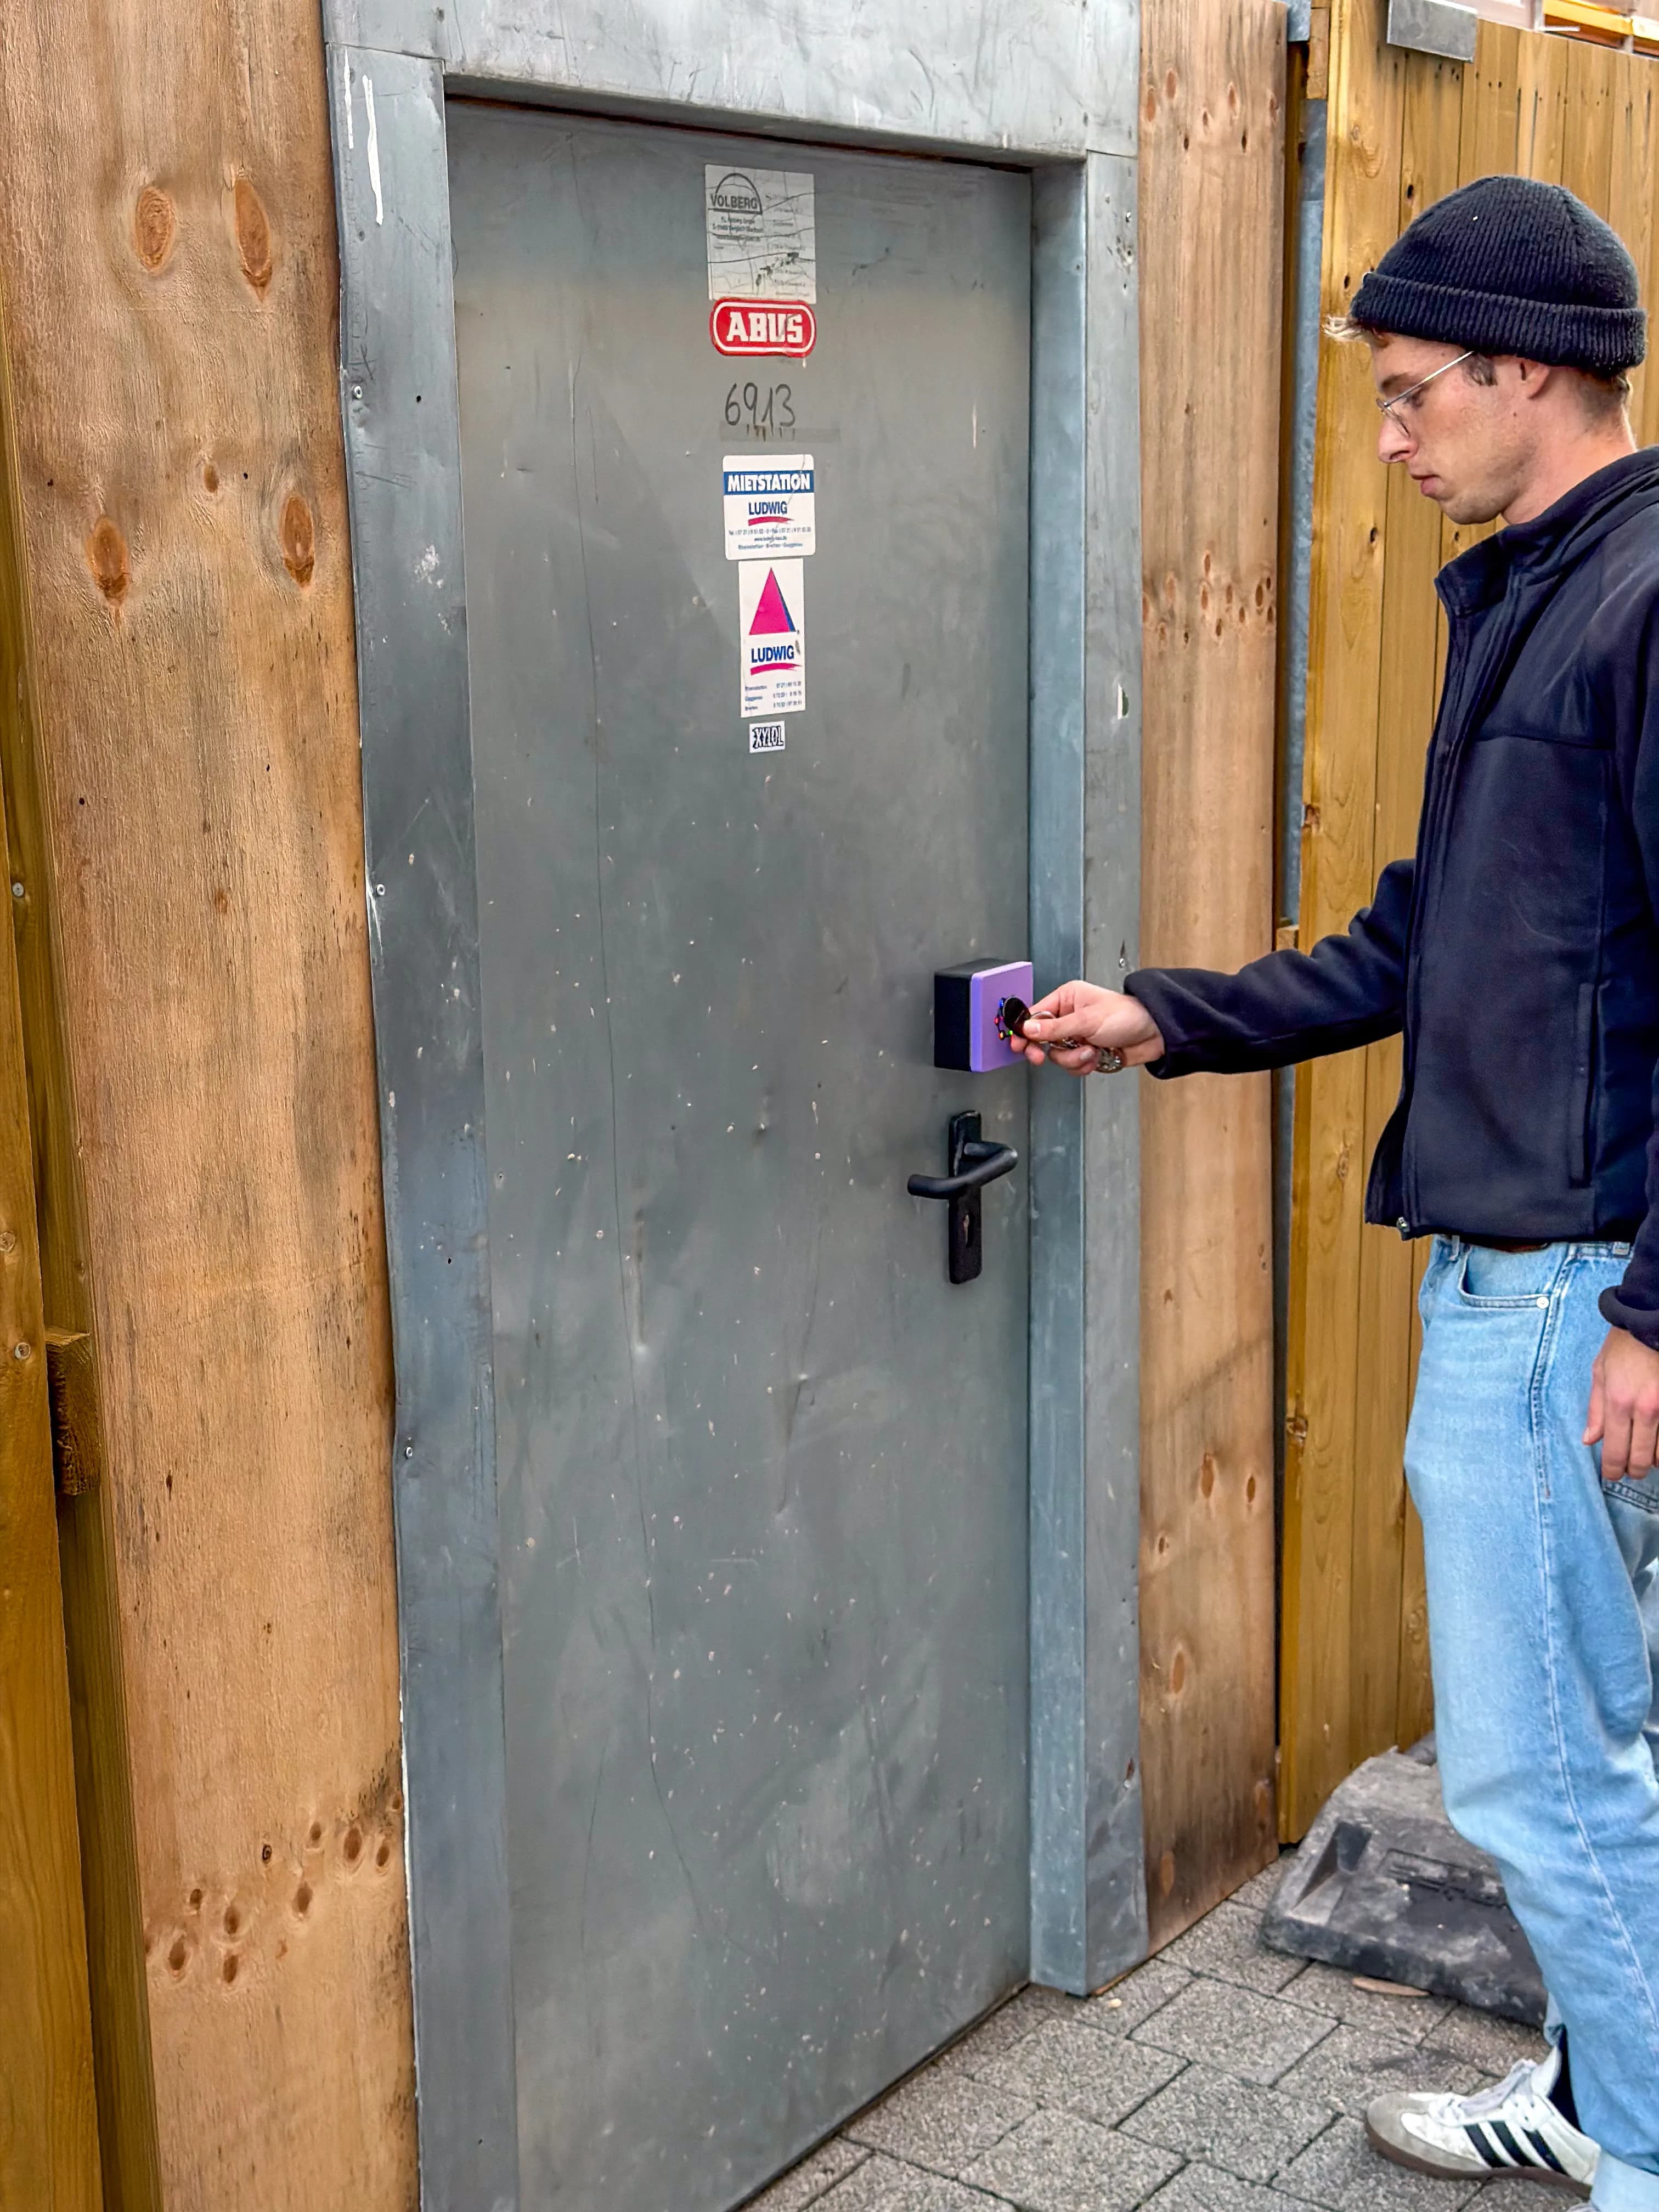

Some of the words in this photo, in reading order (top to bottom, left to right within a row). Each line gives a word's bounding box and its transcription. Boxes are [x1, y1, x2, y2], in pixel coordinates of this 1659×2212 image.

[711, 194, 758, 210] VOLBERG
[726, 312, 803, 343] ABUS
[727, 473, 811, 492] MIETSTATION
[748, 501, 788, 515] LUDWIG
[751, 645, 795, 663] LUDWIG
